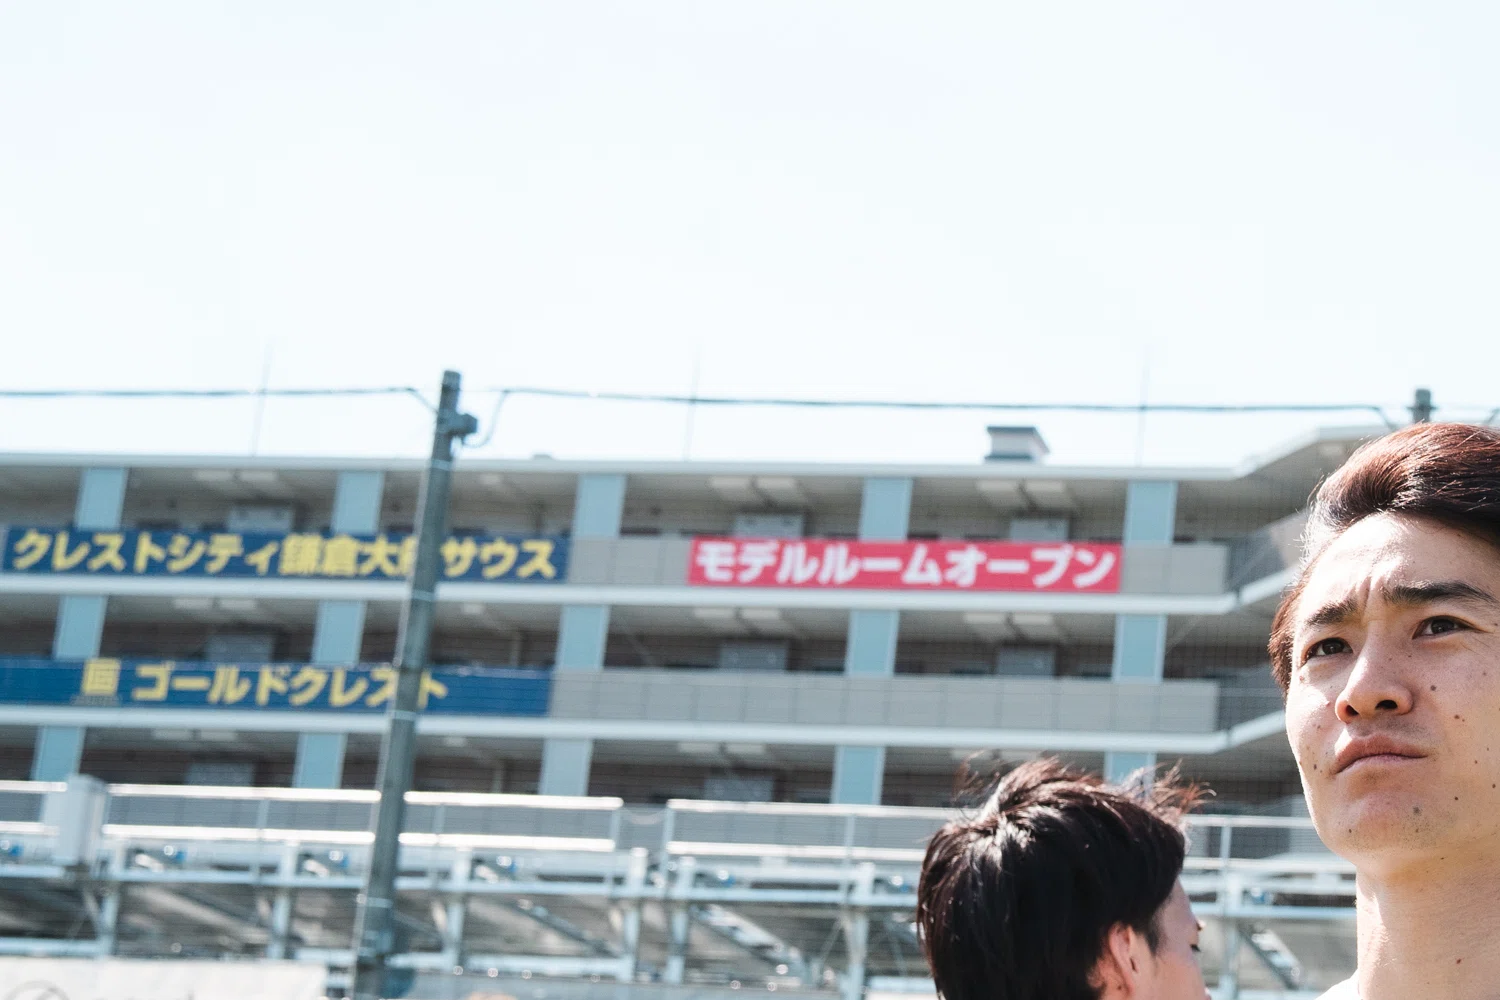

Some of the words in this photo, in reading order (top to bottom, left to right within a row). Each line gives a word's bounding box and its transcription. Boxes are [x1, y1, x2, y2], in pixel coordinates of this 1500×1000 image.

[696, 541, 1115, 588] モデルルームオープン
[131, 661, 448, 709] ゴールドクレスト
